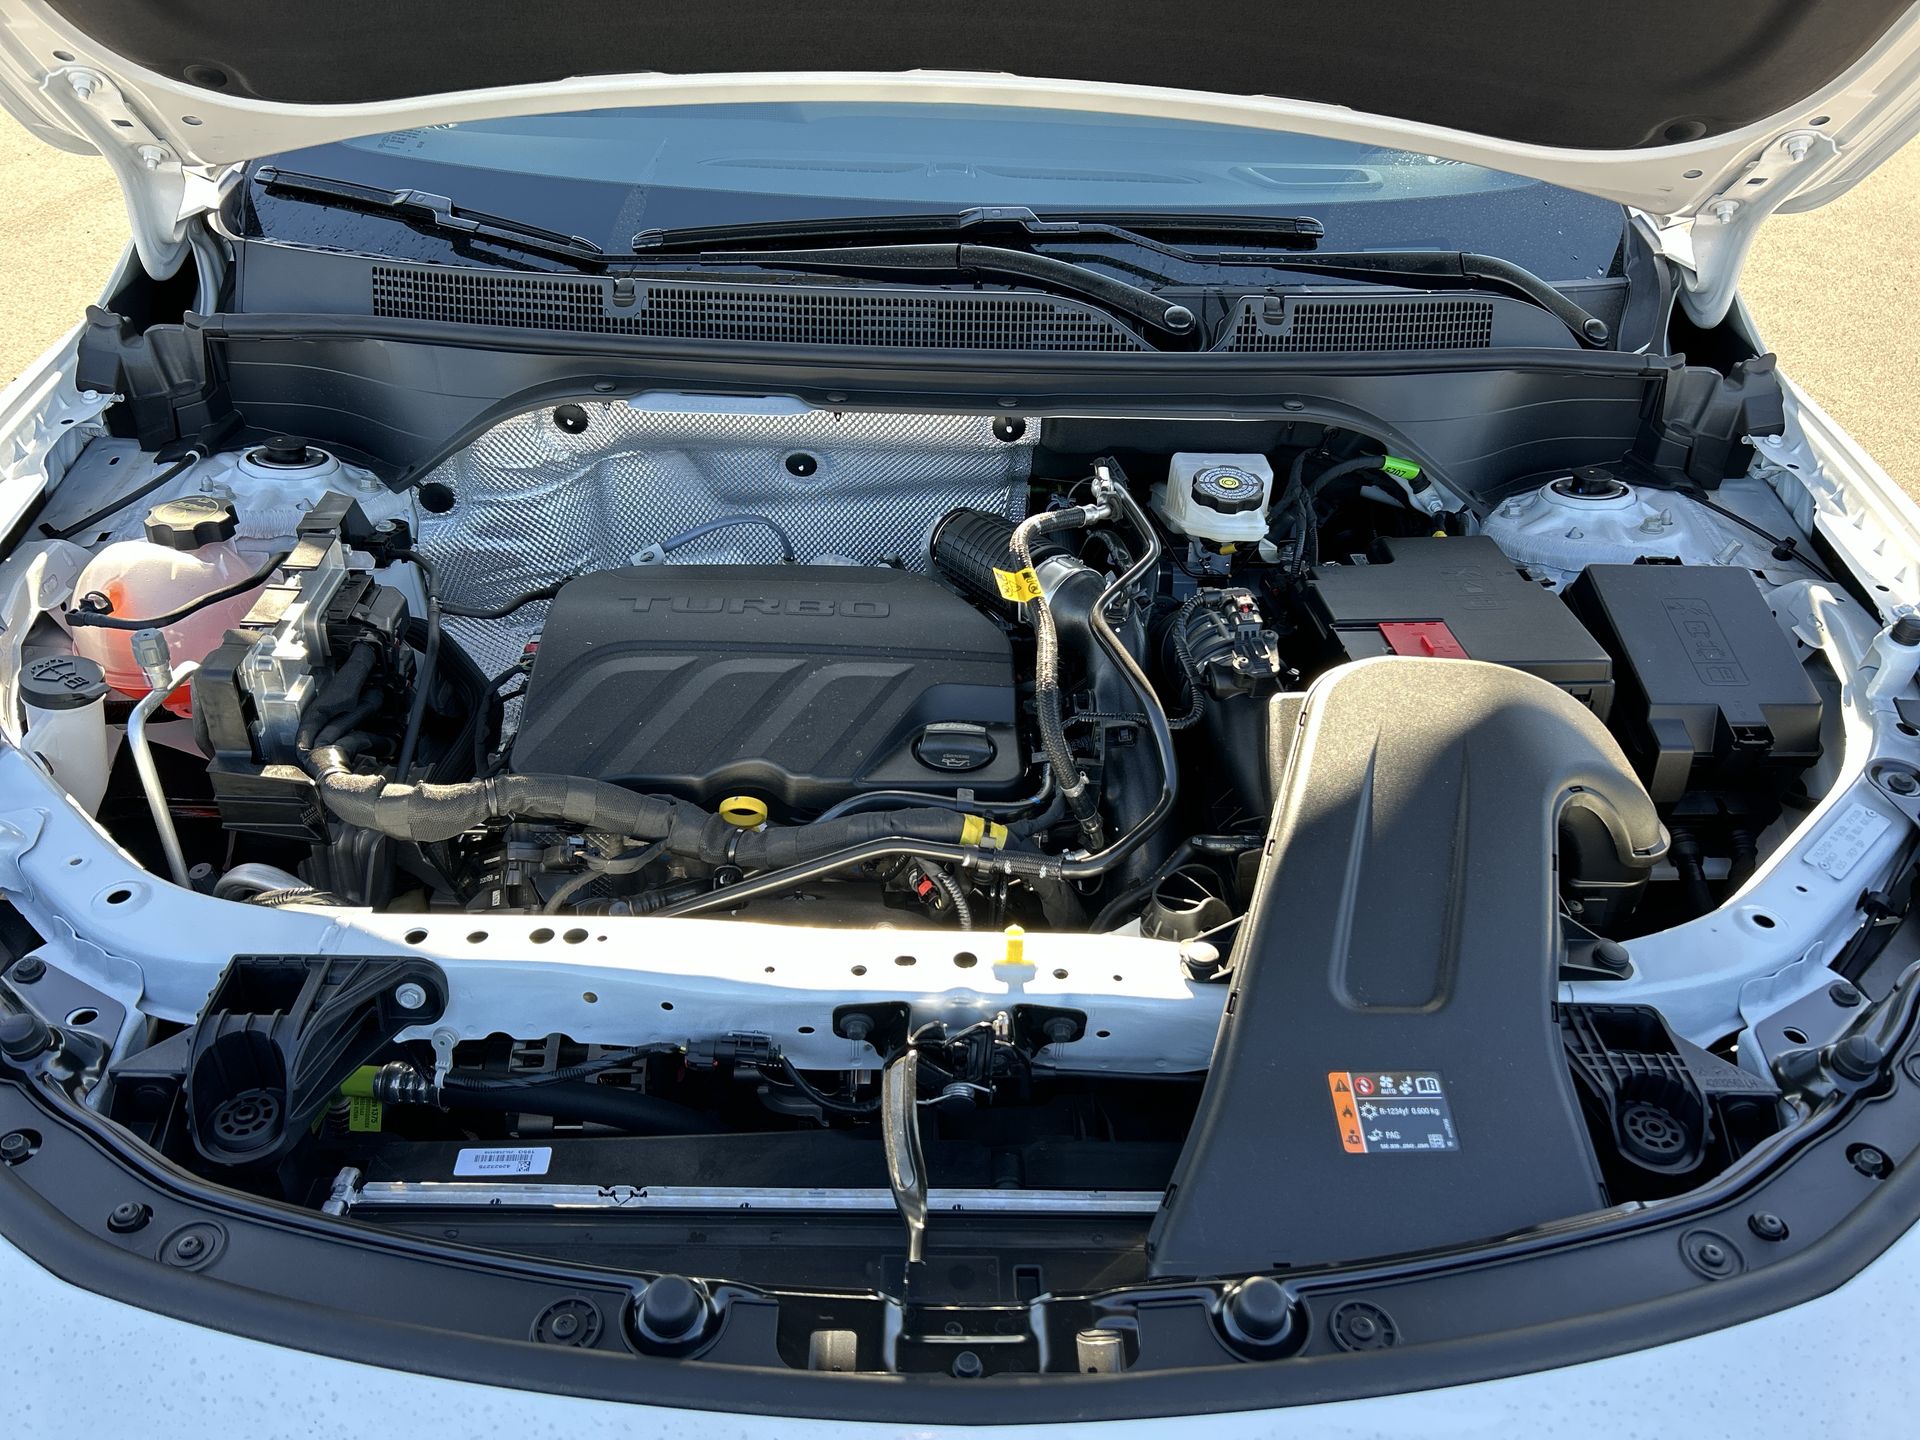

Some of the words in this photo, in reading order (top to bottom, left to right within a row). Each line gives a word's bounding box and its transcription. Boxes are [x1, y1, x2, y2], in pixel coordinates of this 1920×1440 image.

[618, 597, 891, 618] TURBO
[1379, 1107, 1410, 1117] R-1234yf
[1430, 1107, 1440, 1116] kg
[1385, 1130, 1401, 1139] PAG
